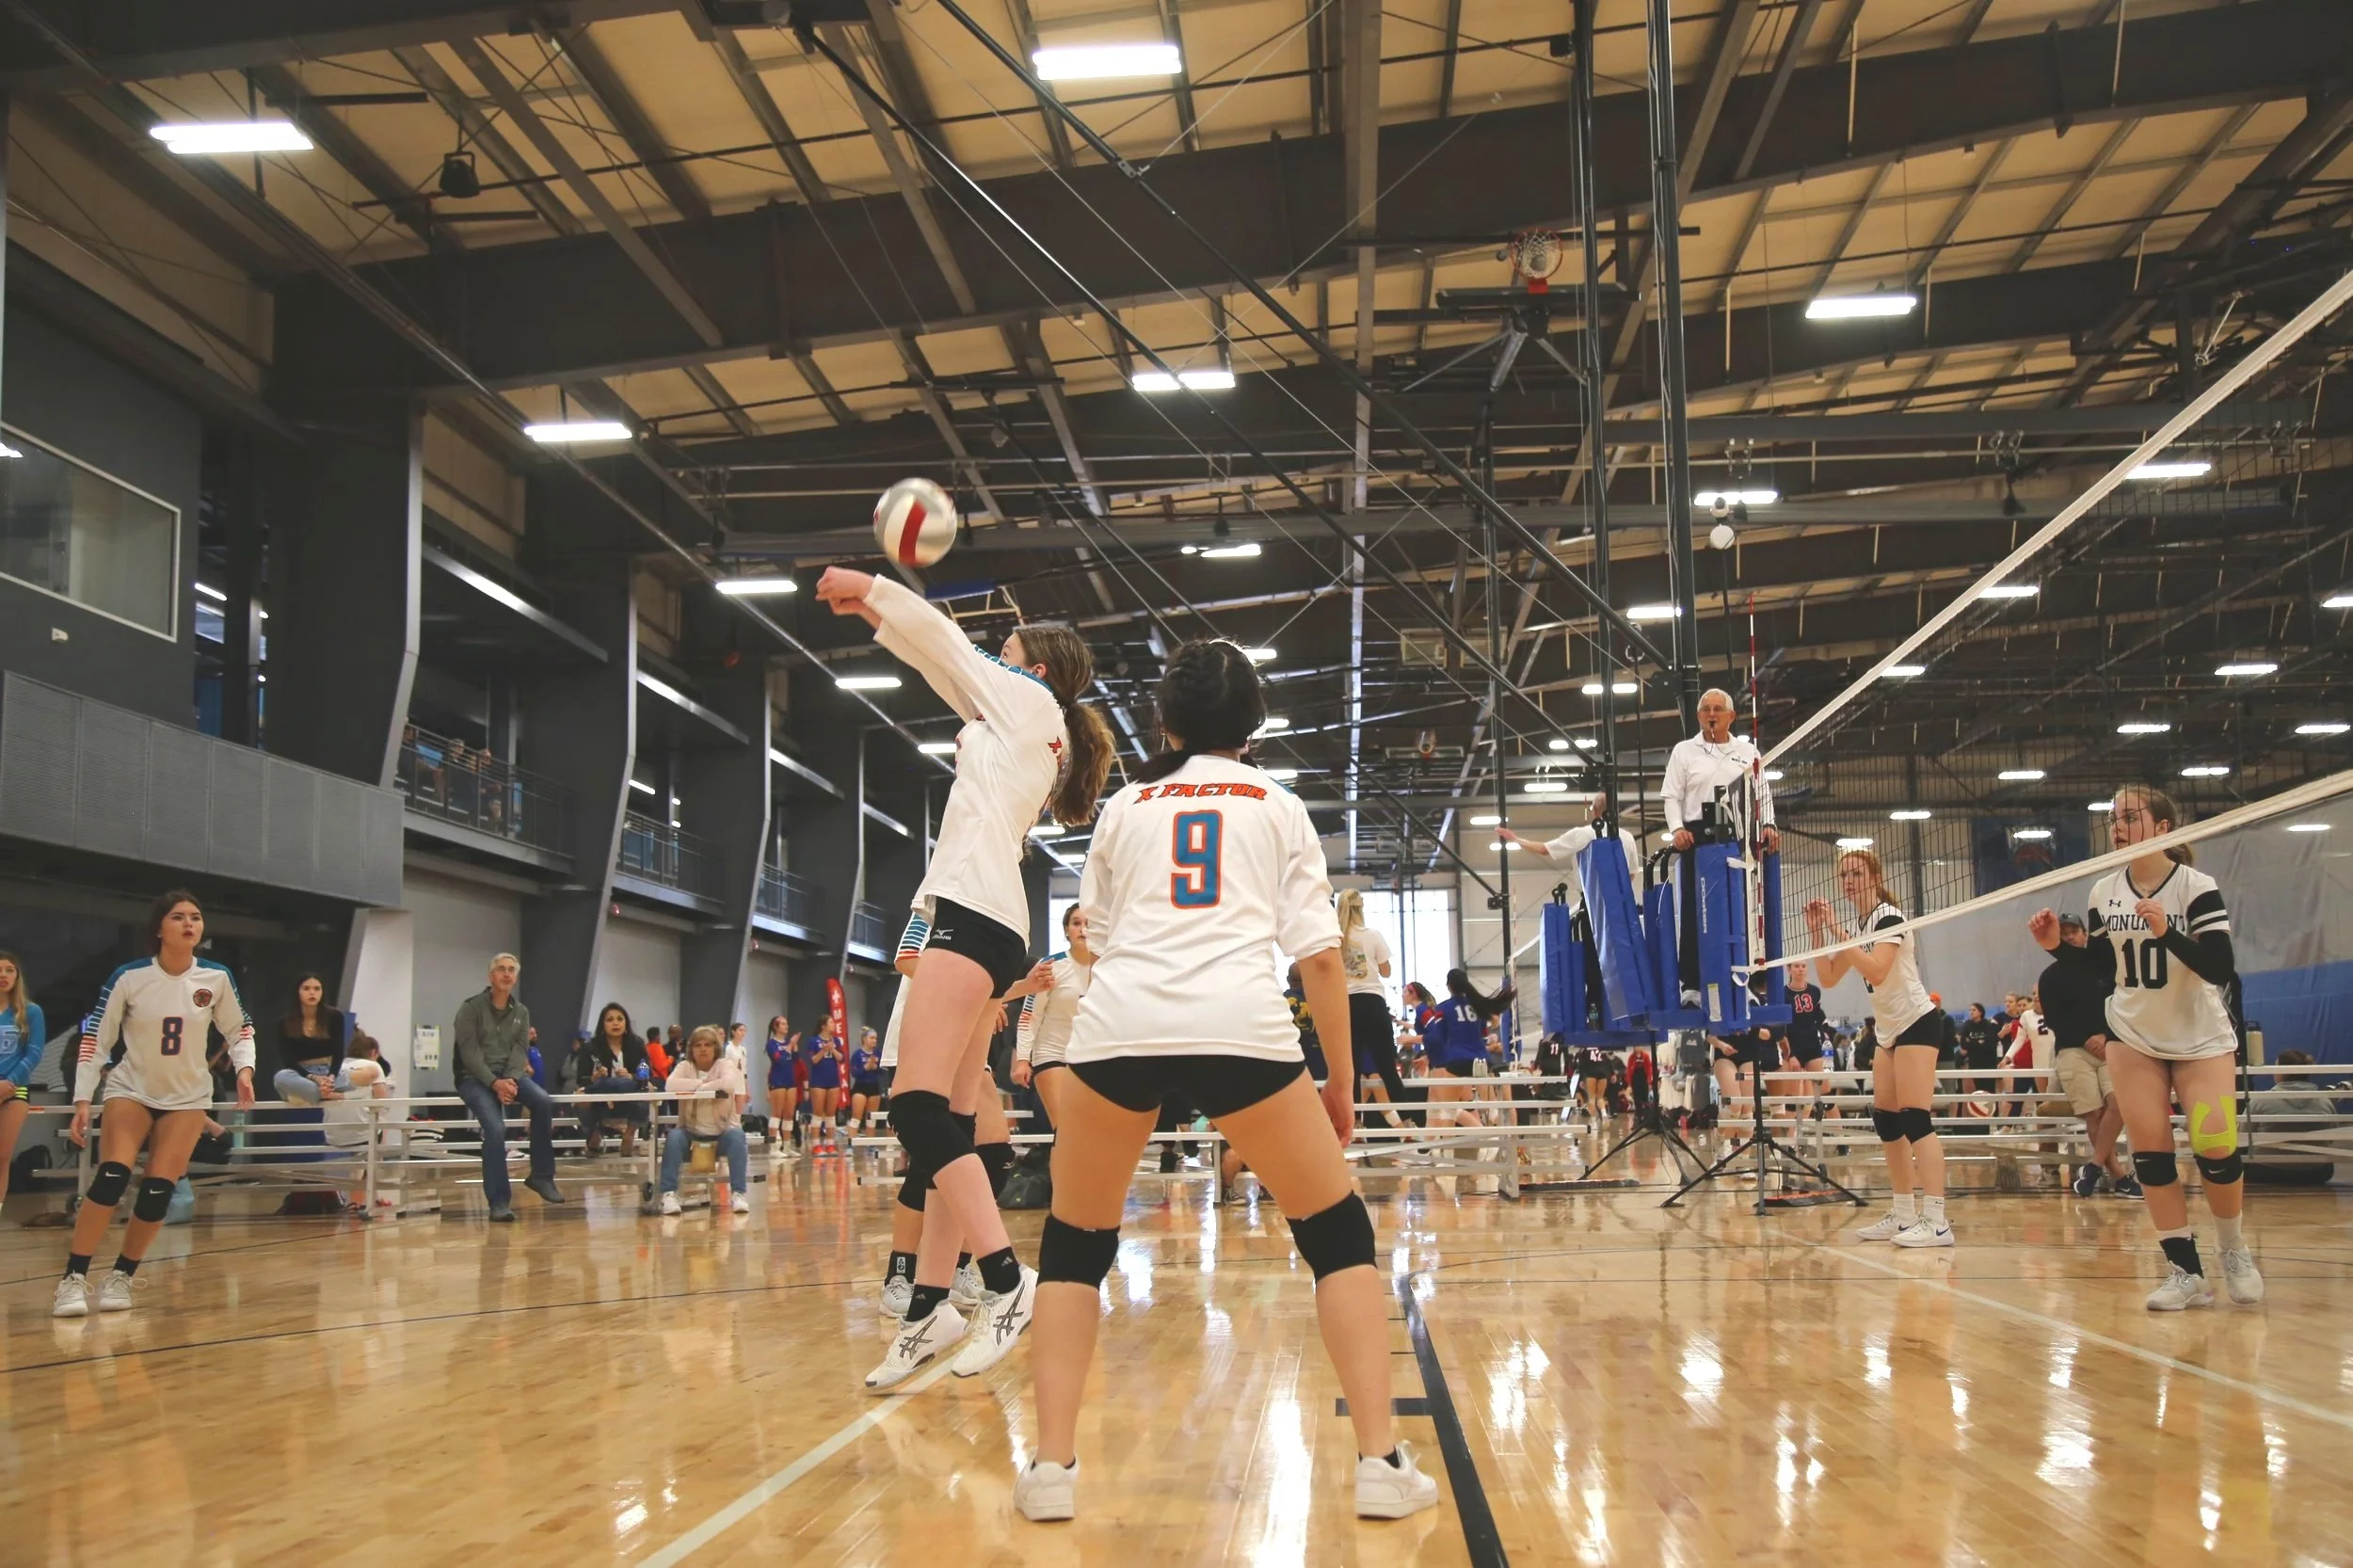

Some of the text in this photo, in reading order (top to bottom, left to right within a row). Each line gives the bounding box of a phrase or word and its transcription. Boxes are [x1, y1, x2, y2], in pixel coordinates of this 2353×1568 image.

[1133, 783, 1268, 805] X FACTOR
[1170, 809, 1224, 910] 9
[2101, 914, 2186, 932] MONUMNT
[2121, 938, 2169, 989] 10
[1794, 993, 1814, 1014] 13
[160, 1016, 184, 1056] 8
[1550, 1043, 1559, 1054] 11
[832, 1008, 849, 1104] MEDCAL
